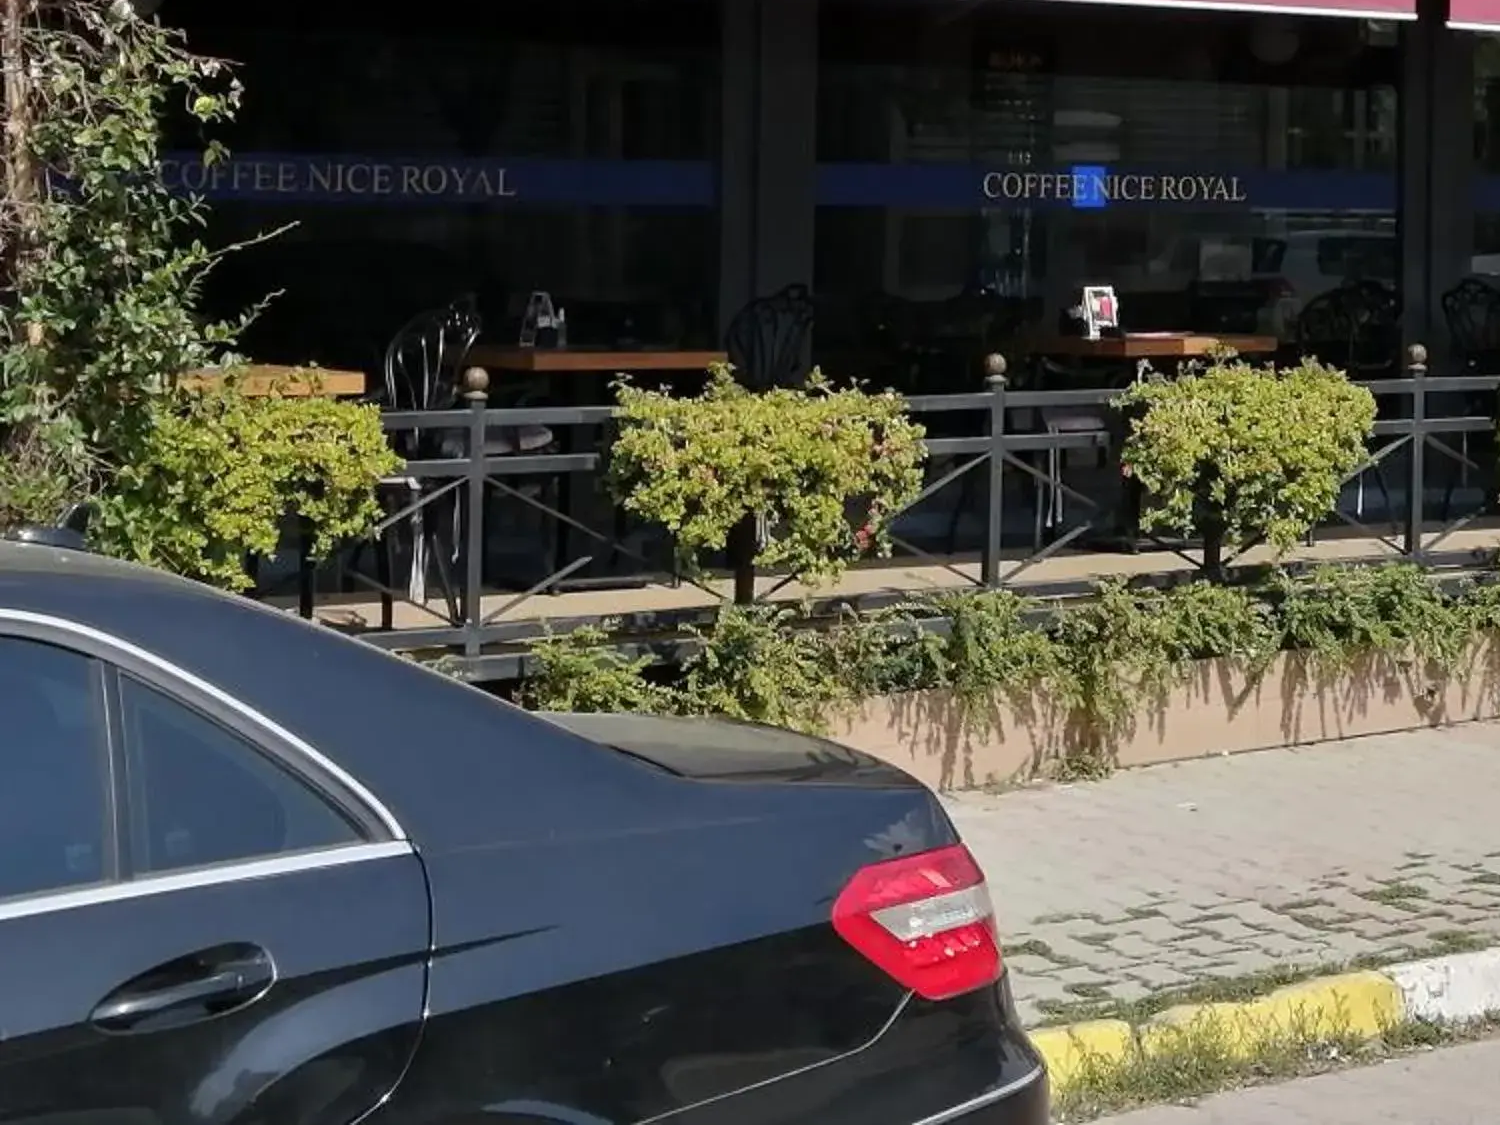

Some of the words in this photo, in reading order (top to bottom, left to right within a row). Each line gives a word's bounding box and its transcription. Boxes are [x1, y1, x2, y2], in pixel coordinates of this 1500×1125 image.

[158, 159, 298, 193] COFFEE
[307, 160, 393, 195] NICE
[401, 164, 518, 198] ROYAL
[983, 172, 1088, 201] COFFEE
[1093, 174, 1156, 202] NICE
[1161, 176, 1248, 203] ROYAL
